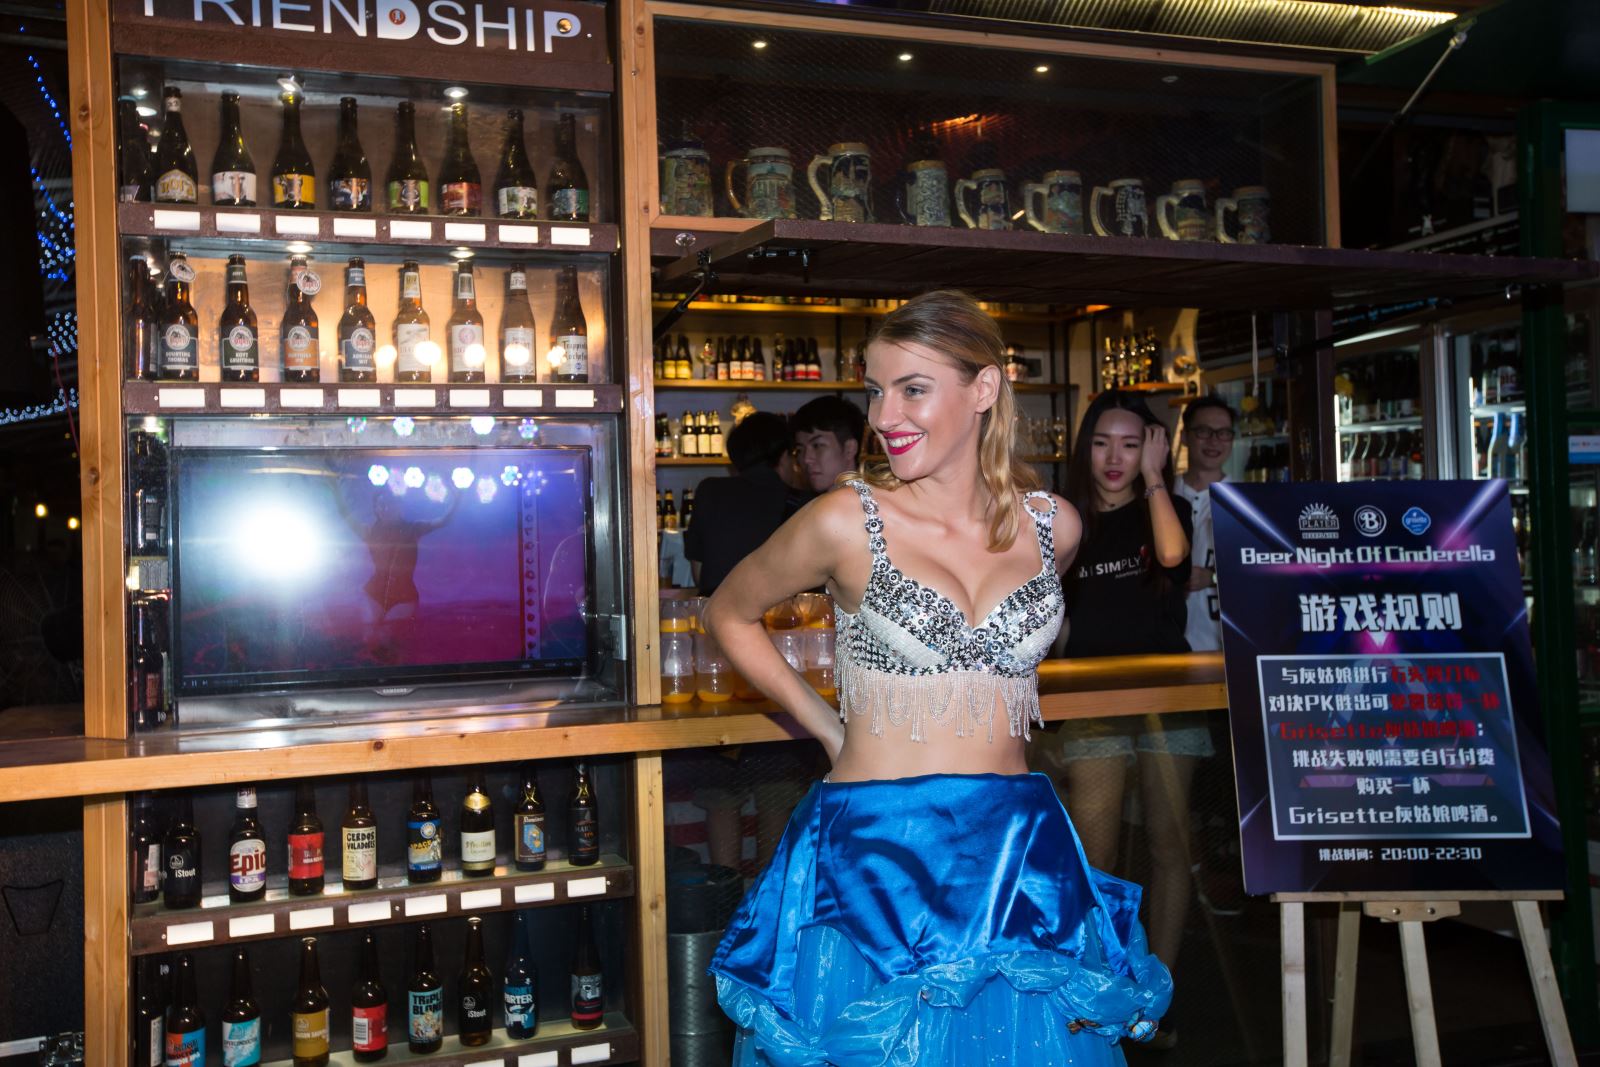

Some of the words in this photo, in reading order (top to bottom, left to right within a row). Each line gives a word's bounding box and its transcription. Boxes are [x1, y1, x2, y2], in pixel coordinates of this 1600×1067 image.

[1095, 556, 1141, 576] SIMPLY
[1240, 547, 1293, 566] Beer
[1296, 547, 1354, 569] Night
[1357, 546, 1384, 563] Of
[1385, 545, 1495, 563] Cinderella
[1299, 592, 1463, 632] 游戏规则
[1292, 748, 1496, 768] 挑战失败则需要自行付费
[1356, 776, 1431, 796] 购买一杯
[1289, 804, 1498, 825] Grisette灰姑娘啤酒。
[346, 831, 375, 842] CERDOS
[1381, 847, 1483, 861] 20:00-22:30
[175, 868, 196, 880] iStout
